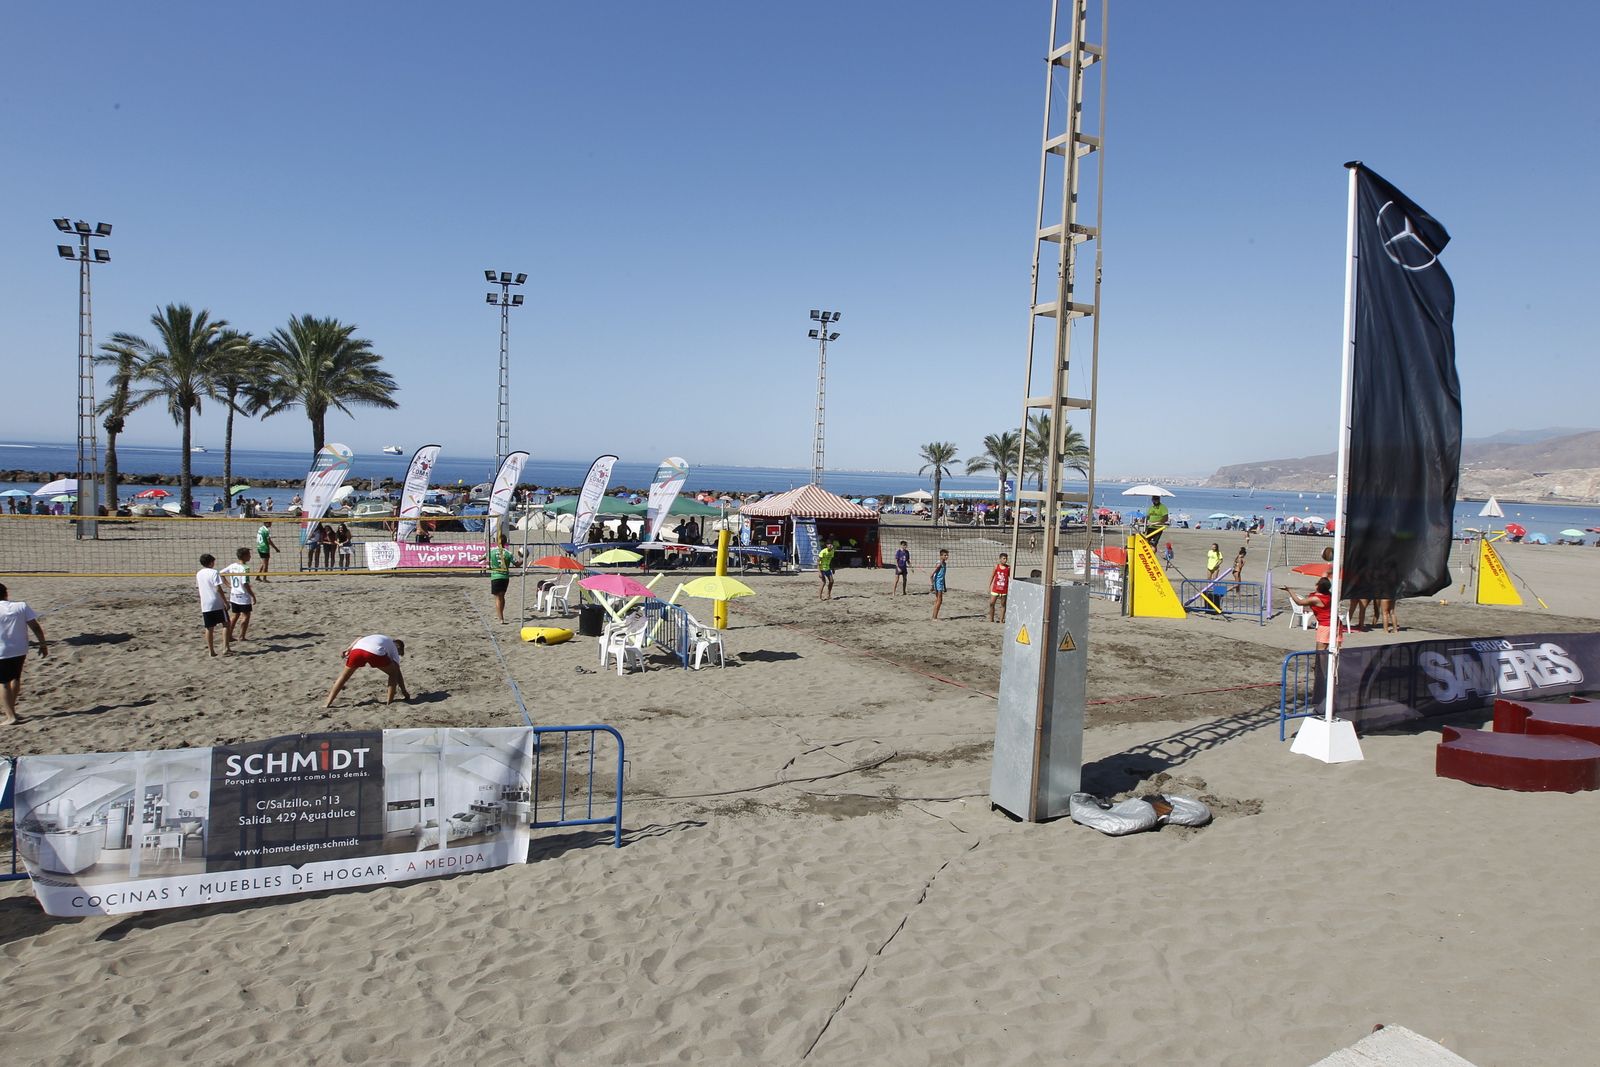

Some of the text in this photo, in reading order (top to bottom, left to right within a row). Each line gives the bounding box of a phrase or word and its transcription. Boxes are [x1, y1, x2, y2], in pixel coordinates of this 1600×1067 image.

[405, 543, 464, 552] Mintonette
[417, 552, 456, 564] Voley
[1472, 639, 1513, 652] GRUPO
[224, 778, 255, 786] Porque
[238, 808, 356, 826] Salida 429 Aguadulce
[234, 838, 359, 857] www.homedesign.schmidt
[71, 887, 169, 908] COCINAS
[178, 885, 189, 898] Y
[200, 875, 282, 895] MUEBLES
[292, 872, 314, 885] DE
[323, 864, 385, 882] HOGAR
[407, 861, 416, 872] A
[425, 852, 485, 870] MEDIDA
